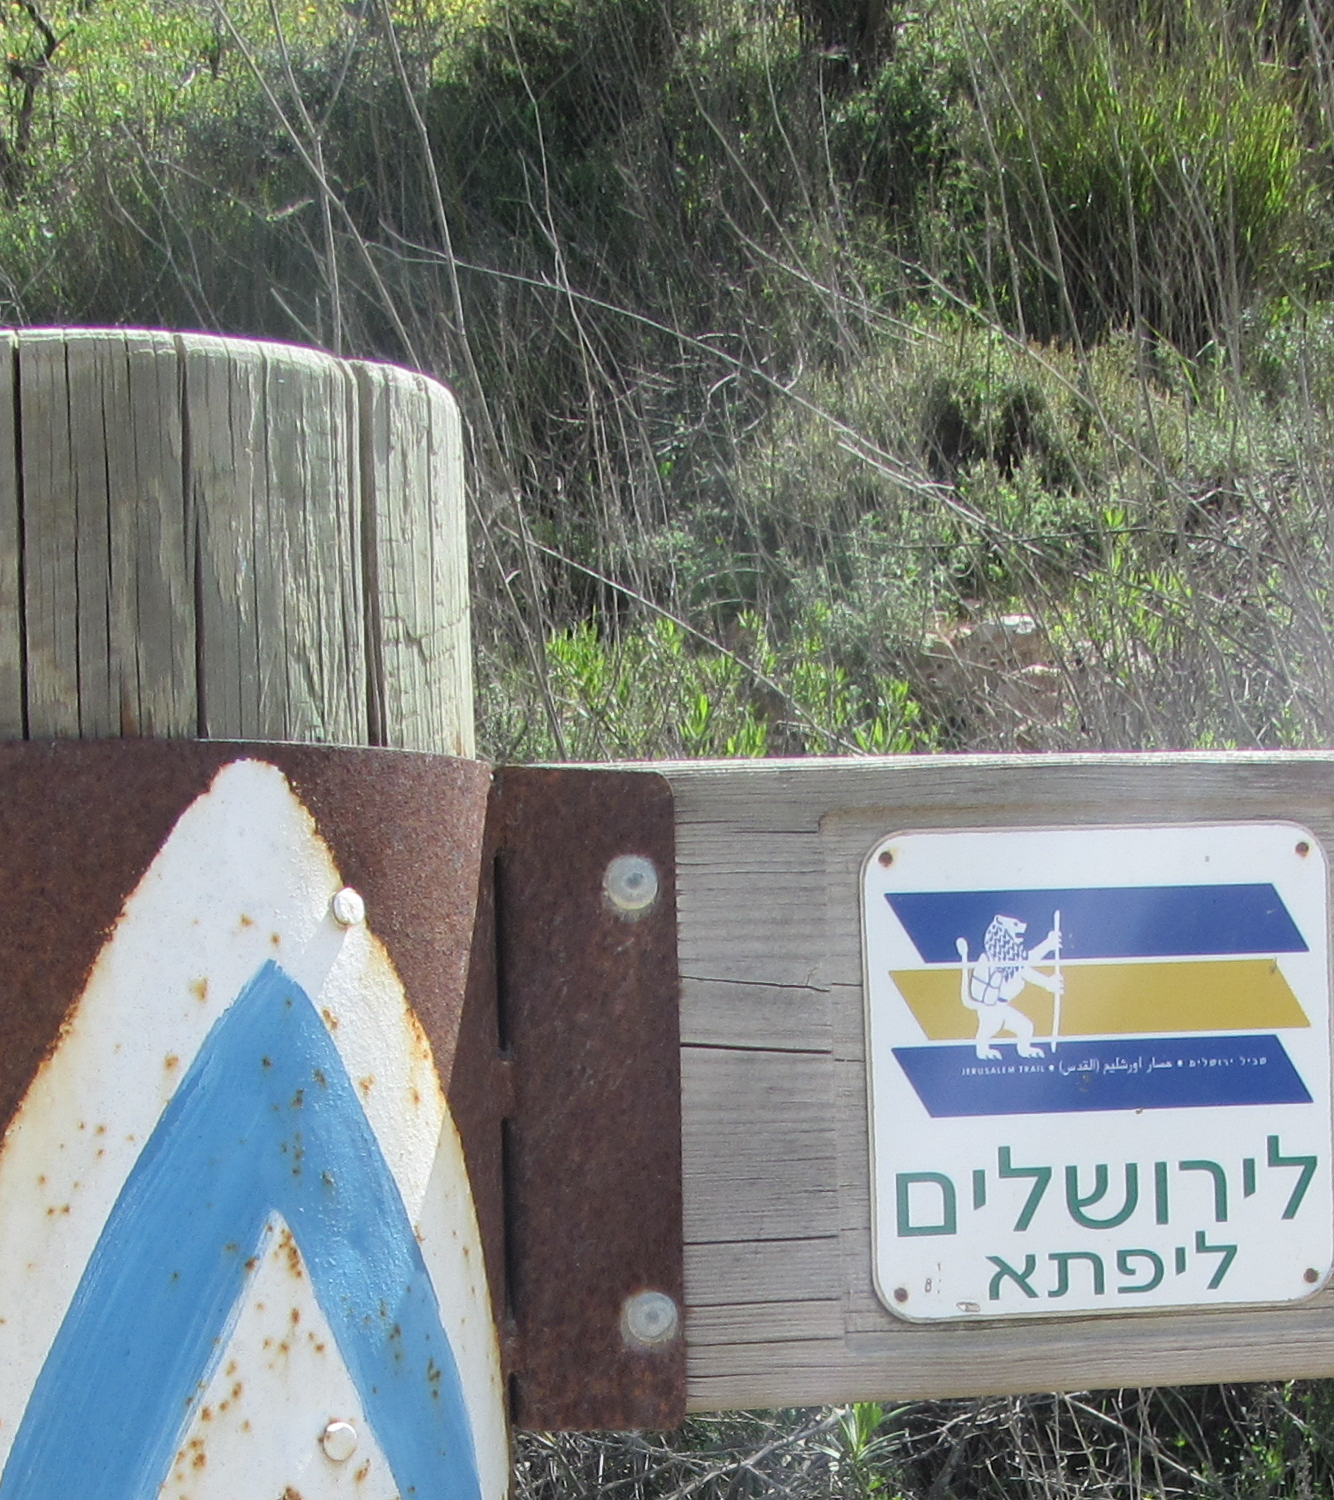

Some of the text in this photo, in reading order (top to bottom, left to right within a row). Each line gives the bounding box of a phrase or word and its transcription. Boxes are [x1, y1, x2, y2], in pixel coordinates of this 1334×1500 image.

[961, 1064, 1045, 1076] JERUSALEM TRAIL
[896, 1135, 1318, 1237] לירושלים
[985, 1231, 1238, 1300] ליפתא
